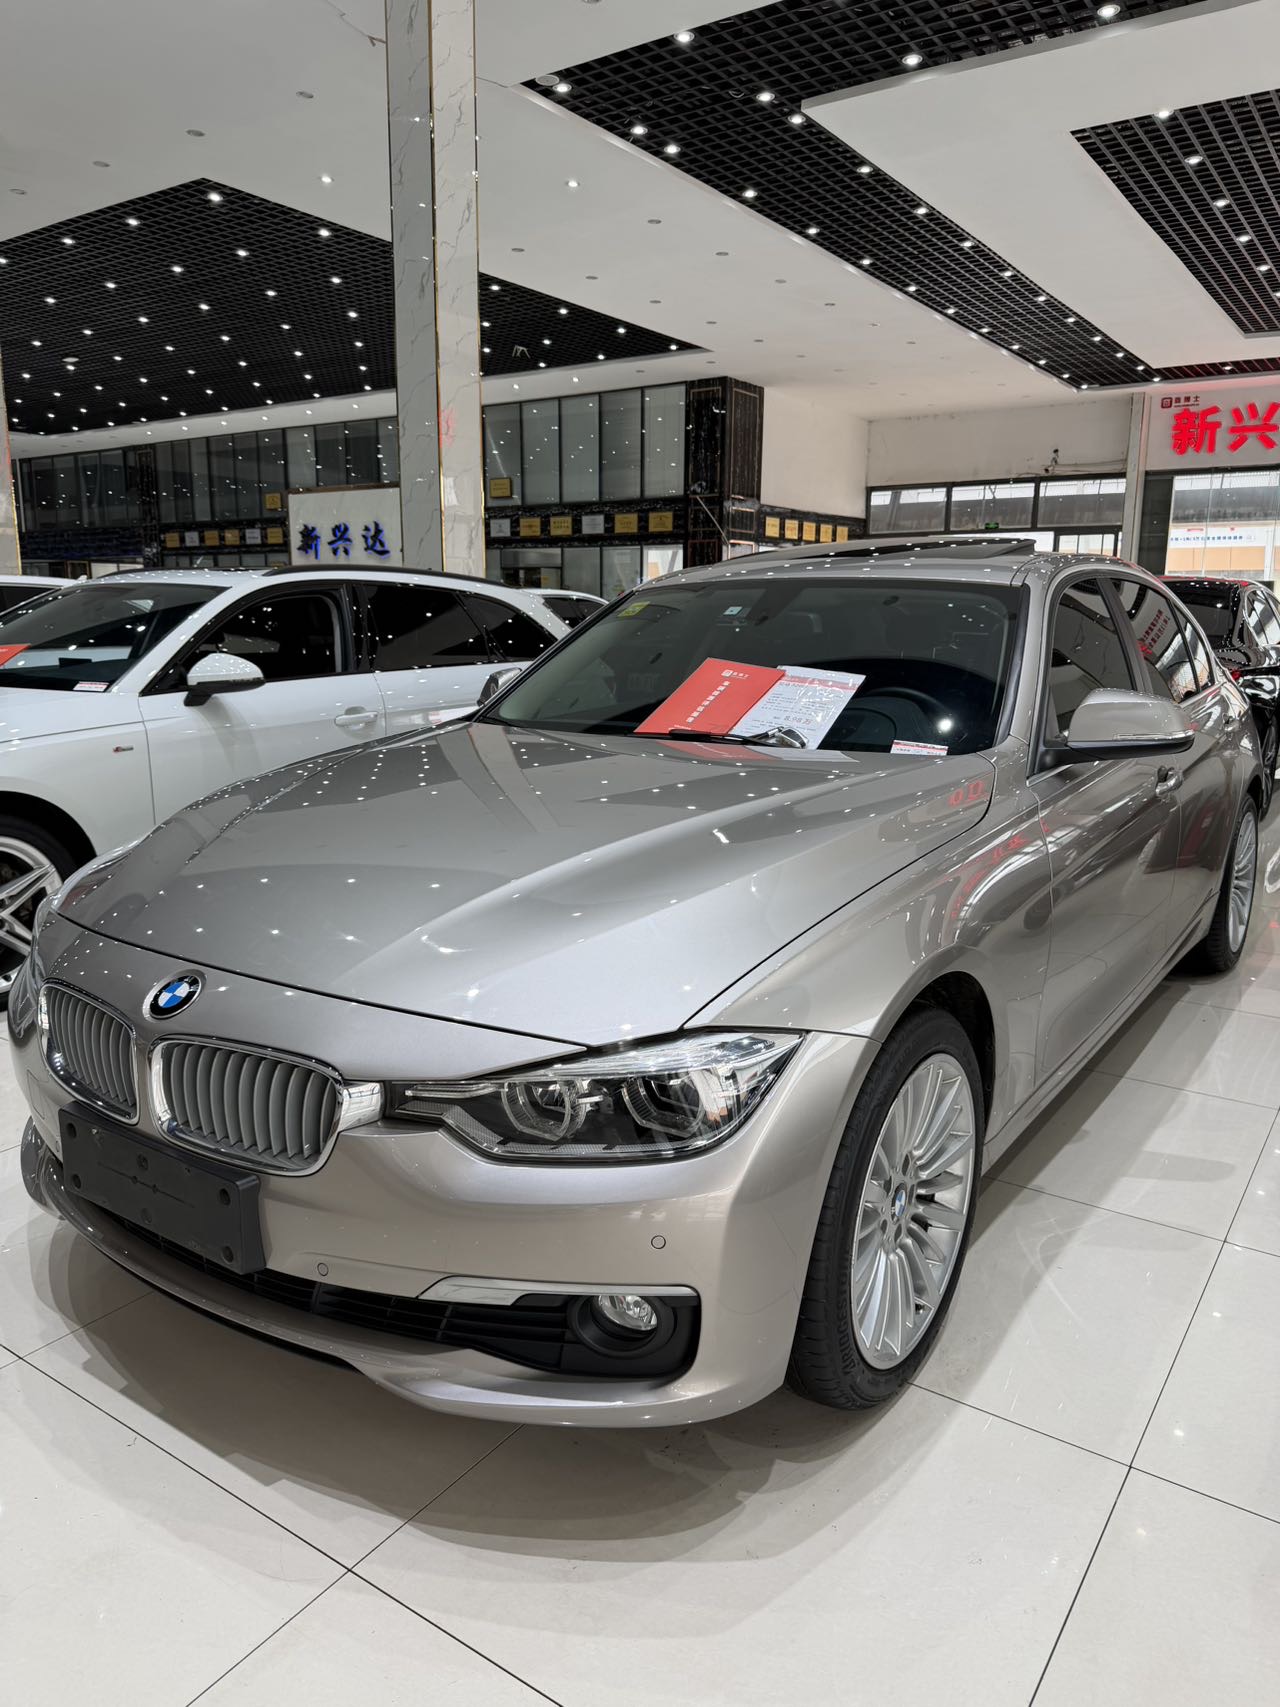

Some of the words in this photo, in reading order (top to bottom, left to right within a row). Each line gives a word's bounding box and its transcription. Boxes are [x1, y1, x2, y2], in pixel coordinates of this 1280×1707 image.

[1171, 402, 1280, 455] 新兴
[297, 520, 391, 560] 新兴达
